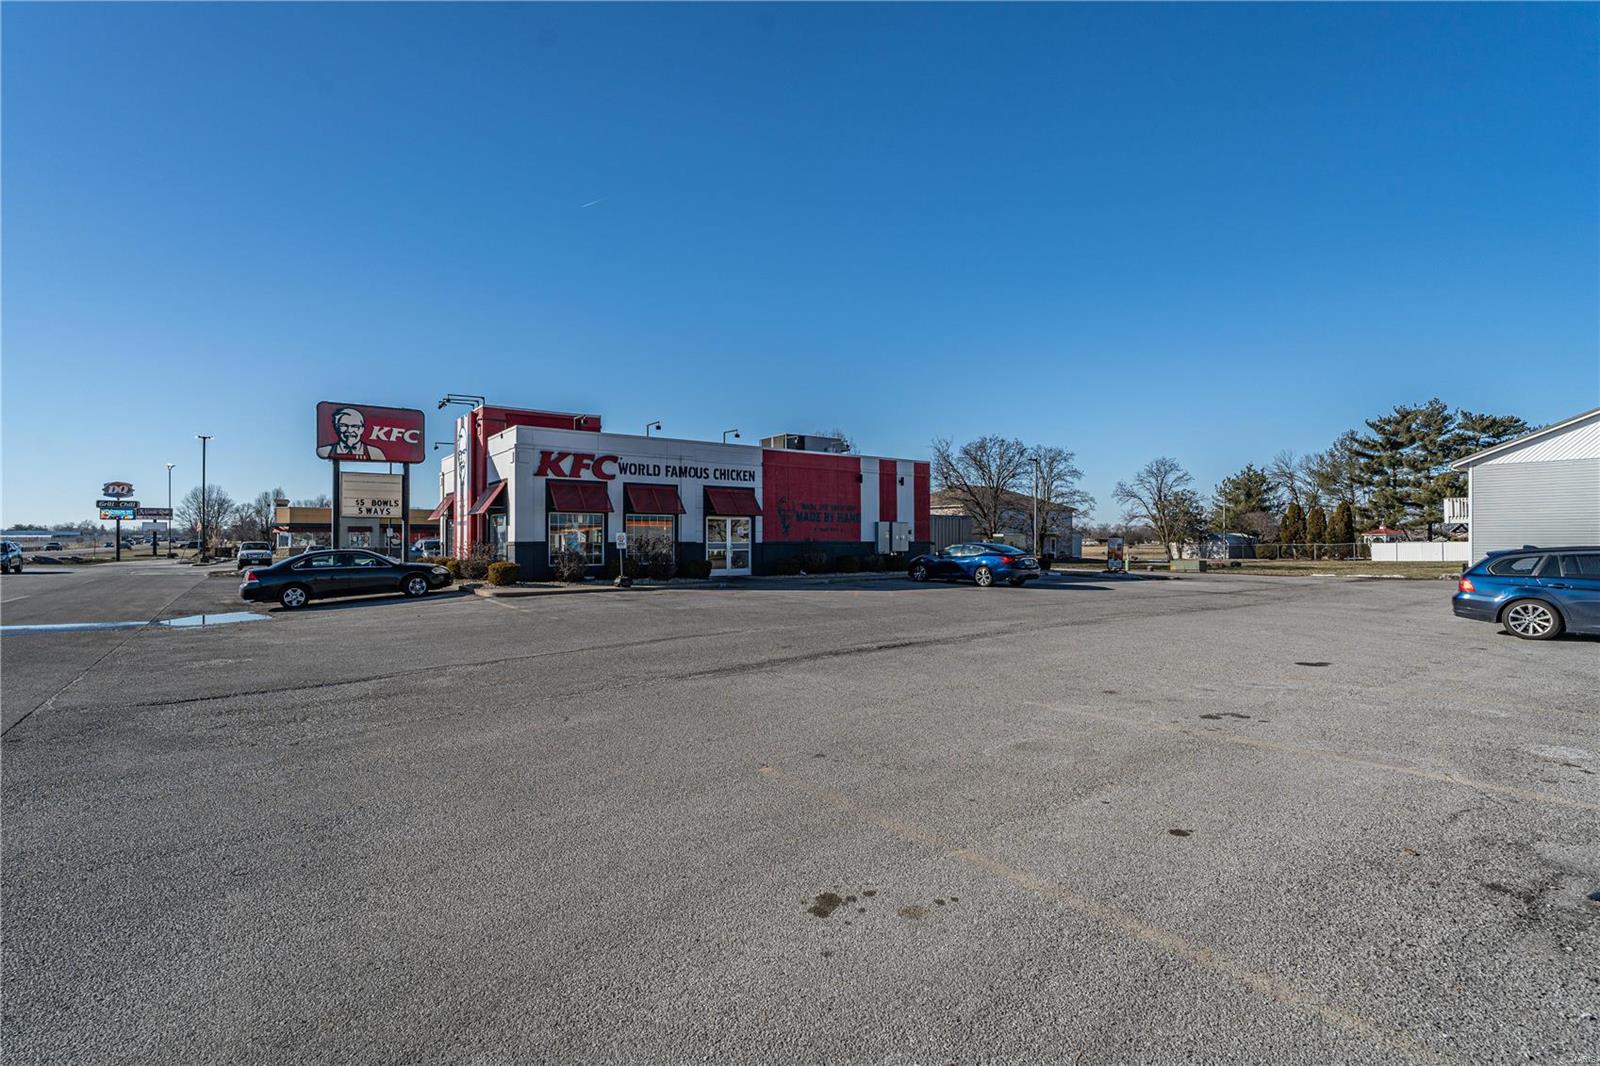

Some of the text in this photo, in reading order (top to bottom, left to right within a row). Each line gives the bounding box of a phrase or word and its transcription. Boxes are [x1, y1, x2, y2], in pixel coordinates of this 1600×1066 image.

[369, 426, 420, 443] KFC
[533, 450, 756, 482] KFC WORLD FAMOUS CHICKEN
[109, 485, 129, 494] DQ
[371, 499, 399, 507] BOWLS
[366, 507, 391, 515] WAYS
